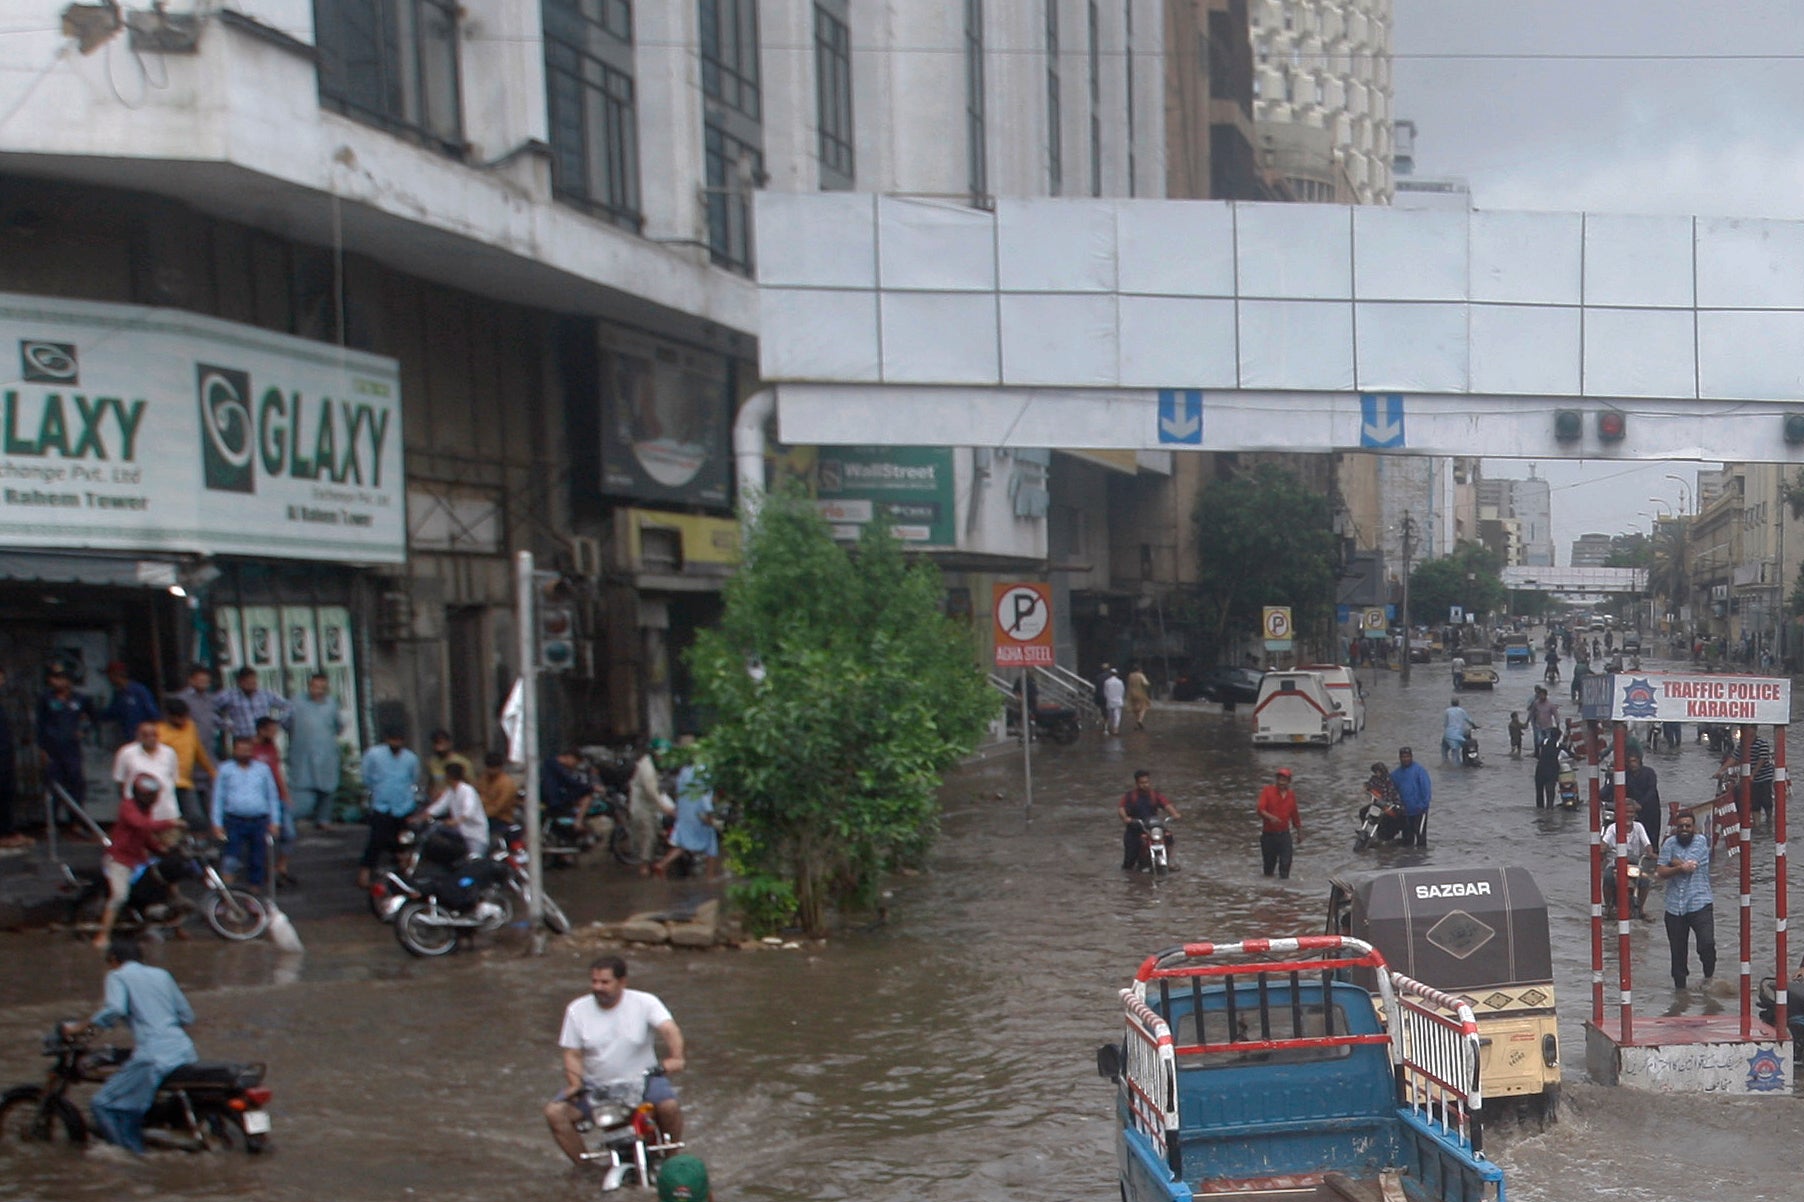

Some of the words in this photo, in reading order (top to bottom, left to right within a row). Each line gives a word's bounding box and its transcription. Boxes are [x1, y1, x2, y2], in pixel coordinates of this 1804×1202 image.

[0, 390, 148, 463] LAXY
[259, 386, 390, 488] GLAXY
[1662, 680, 1725, 699] TRAFFIC
[1728, 682, 1781, 701] POLICE
[1686, 700, 1756, 719] KARACHI
[1415, 881, 1491, 899] SAZGAR
